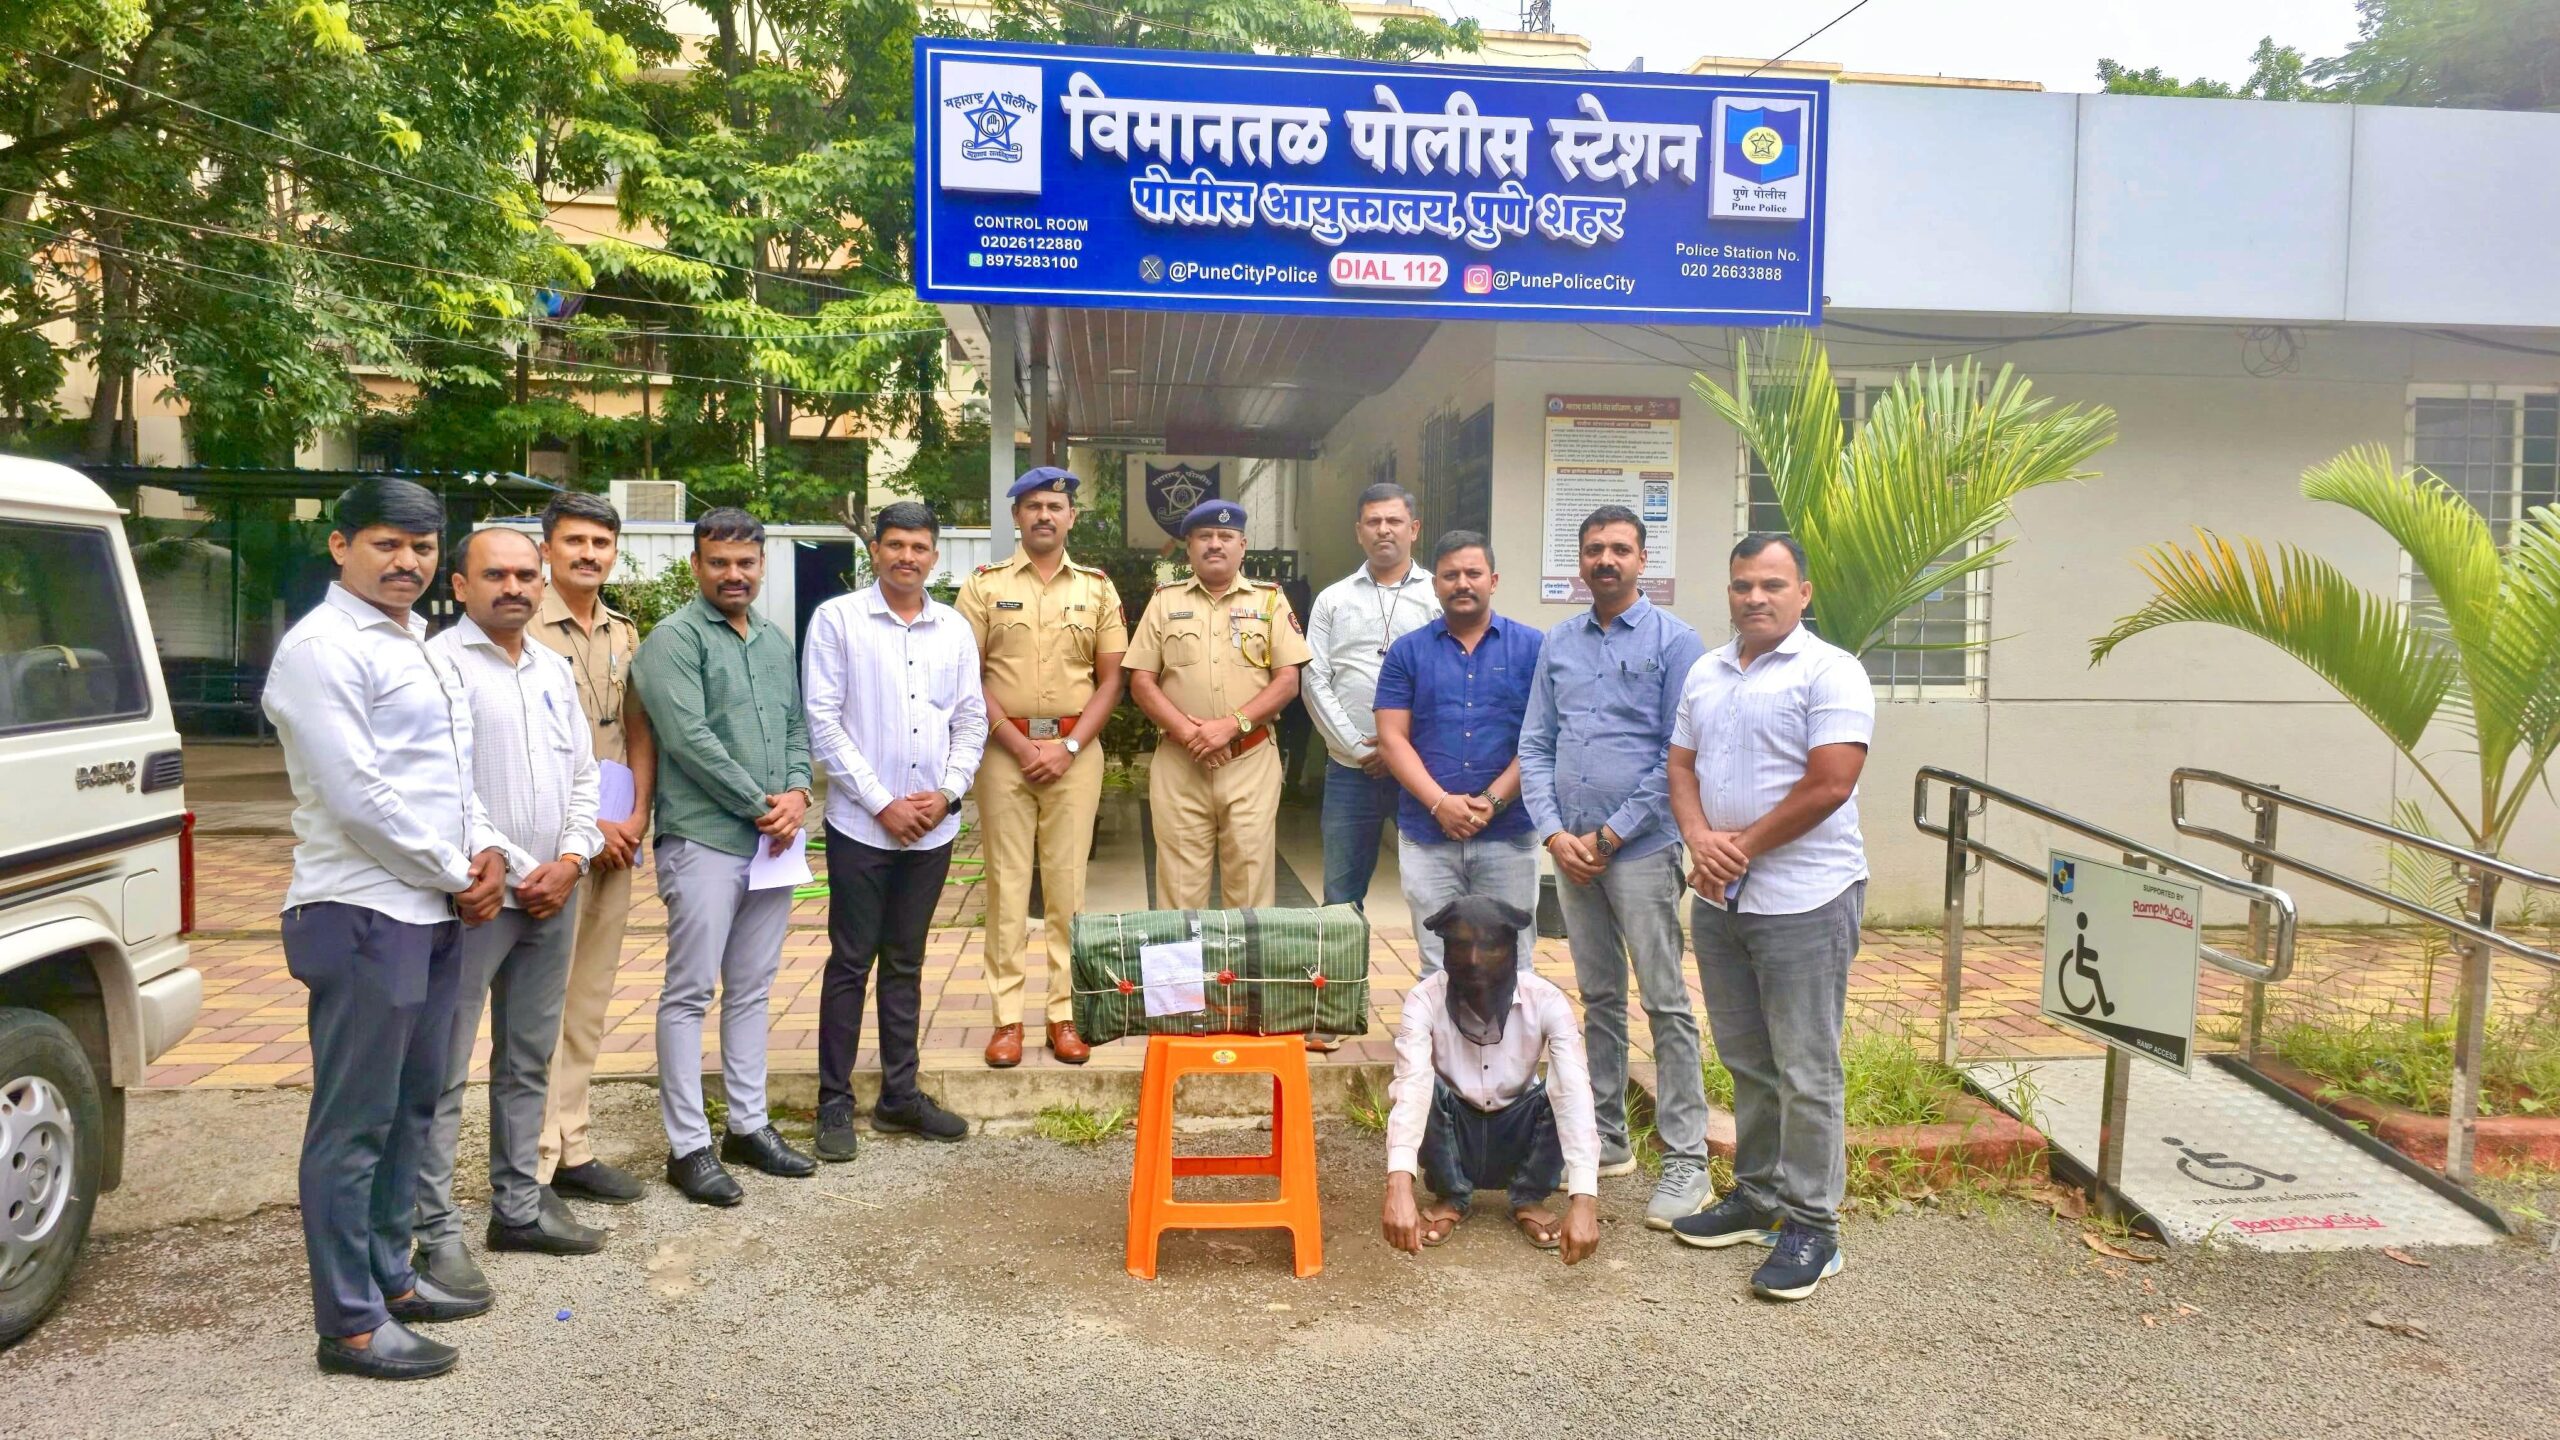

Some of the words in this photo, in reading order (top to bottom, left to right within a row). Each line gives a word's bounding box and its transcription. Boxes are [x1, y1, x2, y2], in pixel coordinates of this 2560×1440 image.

[944, 92, 984, 109] महाराष्ट्र
[1001, 91, 1038, 114] पोलीस
[1060, 71, 1330, 167] विमानतळ
[1344, 84, 1533, 178] पोलीस
[1548, 93, 1702, 188] स्टेशन
[1733, 186, 1749, 201] पुणे
[1754, 187, 1787, 200] पोलीस
[1130, 165, 1257, 226] पोलीस
[1465, 181, 1531, 249] पुणे
[1536, 194, 1626, 249] शहर
[1732, 202, 1756, 212] Pune
[1759, 203, 1787, 213] Police
[974, 215, 1043, 231] CONTROL
[1046, 217, 1089, 232] ROOM
[980, 235, 1083, 251] 02026122880
[985, 253, 1078, 270] 8975283100
[1675, 243, 1719, 259] Police
[1722, 245, 1773, 260] Station
[1777, 247, 1801, 262] No.
[1169, 262, 1318, 285] @PuneCityPolice
[1336, 258, 1395, 282] DIAL
[1403, 261, 1442, 283] 112
[1681, 264, 1708, 279] 020
[1712, 265, 1782, 281] 26633888
[1492, 270, 1636, 295] @PunePoliceCity
[2143, 884, 2176, 899] SUPPORTED
[2176, 894, 2185, 902] BY
[2132, 900, 2194, 927] RampMyCity
[2136, 1038, 2153, 1050] RAMP
[2153, 1046, 2177, 1062] ACCESS
[2192, 1198, 2247, 1206] PLEASE
[2250, 1195, 2274, 1203] USE
[2278, 1191, 2362, 1202] ASSISTANCE
[2231, 1214, 2382, 1231] RampMyCity
